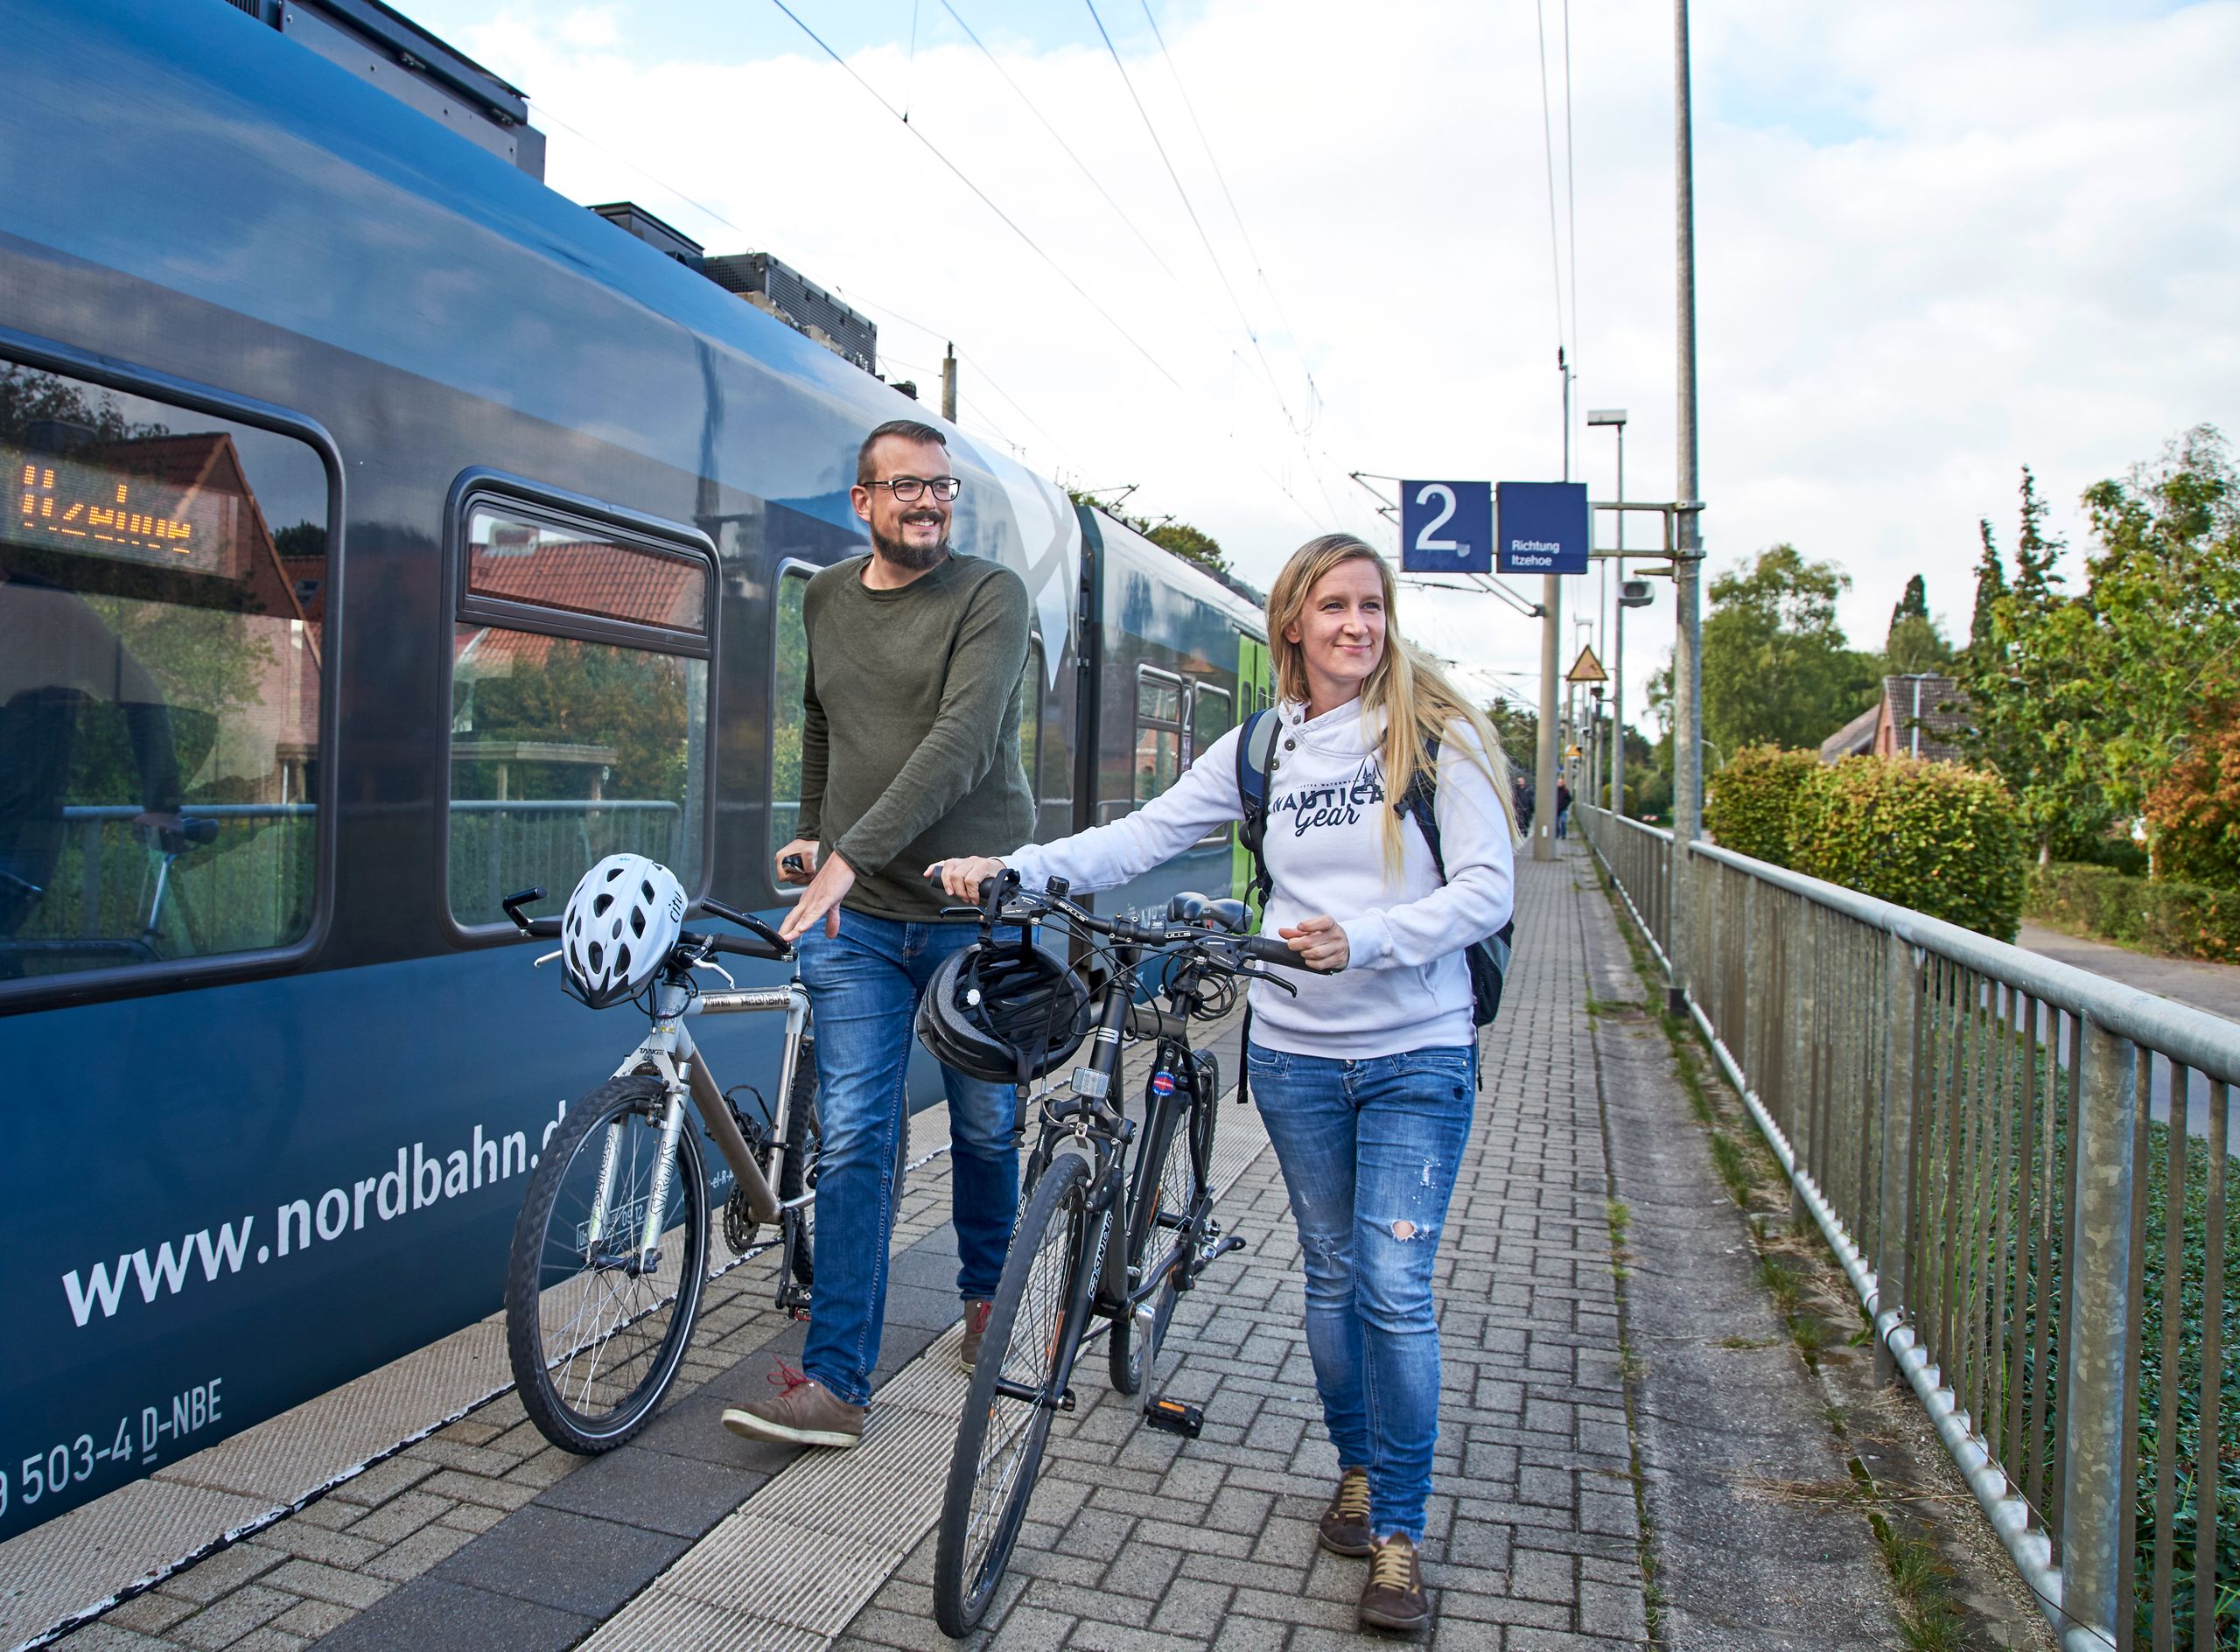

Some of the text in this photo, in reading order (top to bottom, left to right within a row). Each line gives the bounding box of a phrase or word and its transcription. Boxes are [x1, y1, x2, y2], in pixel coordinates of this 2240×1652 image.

[1416, 483, 1457, 550] 2
[1512, 539, 1560, 554] Richtung
[1512, 555, 1552, 566] Itzehoe
[1295, 788, 1360, 837] Gear
[1058, 900, 1089, 922] BULLS
[1165, 930, 1191, 939] ULLS
[23, 1417, 133, 1505] 503-4
[142, 1377, 222, 1466] D-NBE
